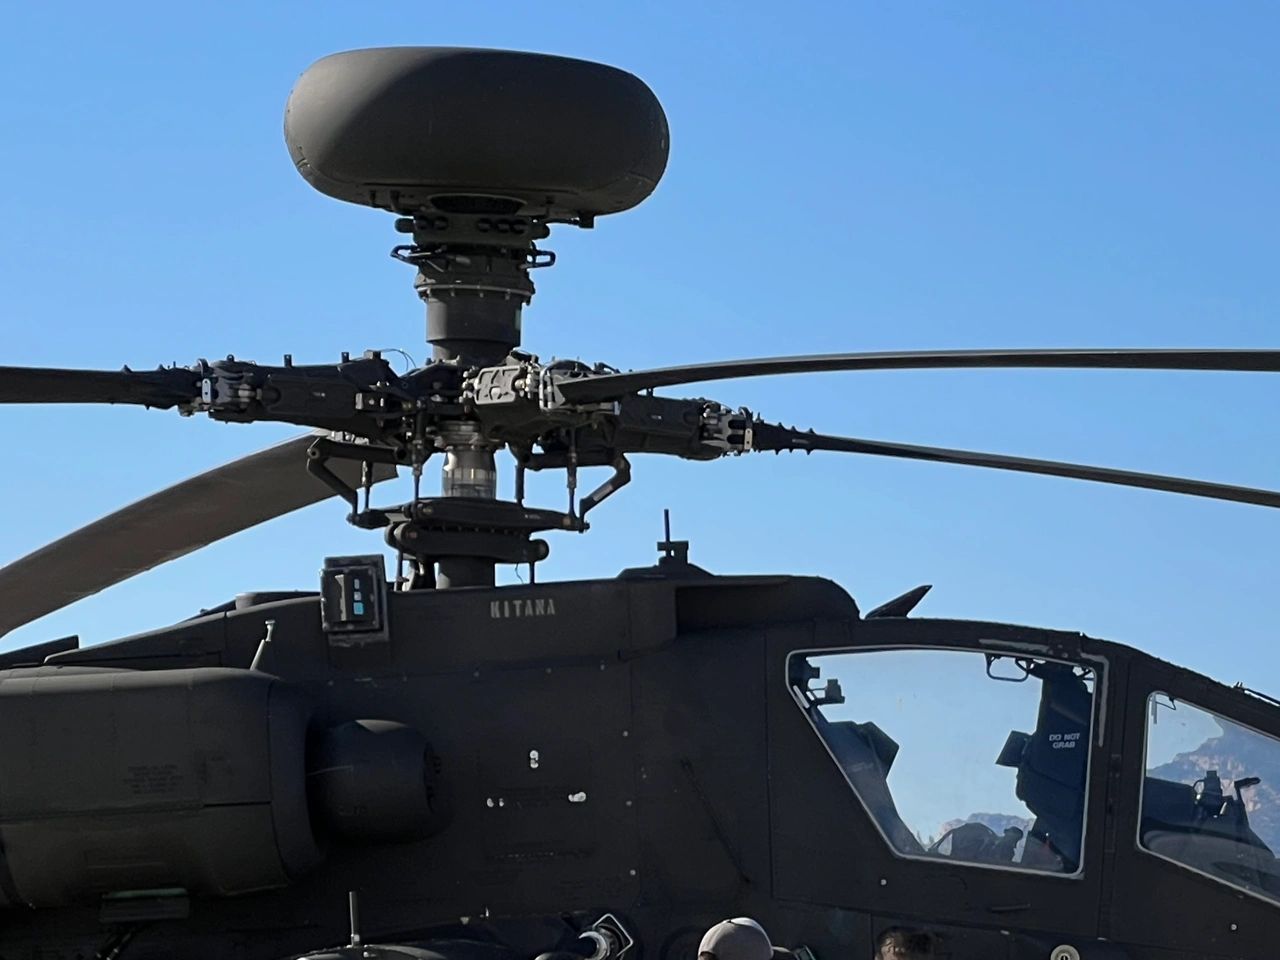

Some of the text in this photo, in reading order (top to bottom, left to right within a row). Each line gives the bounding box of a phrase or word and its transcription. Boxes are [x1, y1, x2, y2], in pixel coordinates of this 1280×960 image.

[490, 599, 556, 618] KITANA
[1049, 732, 1080, 742] DO NOT
